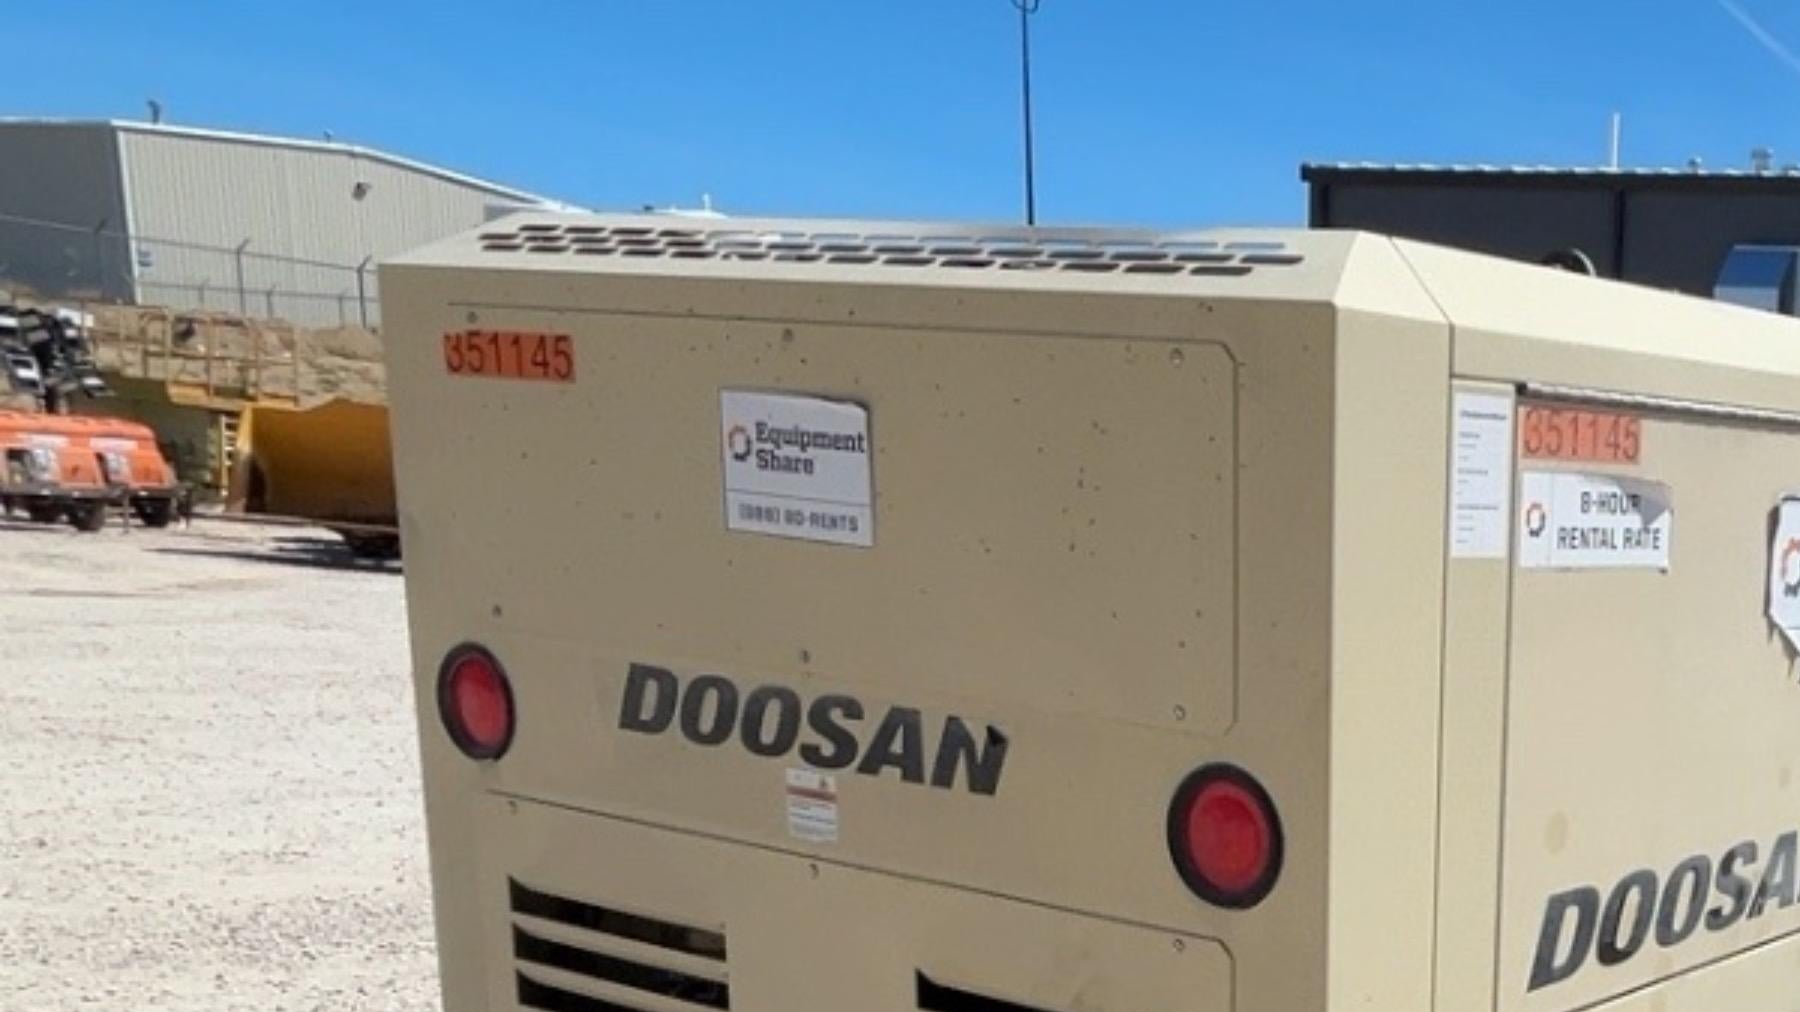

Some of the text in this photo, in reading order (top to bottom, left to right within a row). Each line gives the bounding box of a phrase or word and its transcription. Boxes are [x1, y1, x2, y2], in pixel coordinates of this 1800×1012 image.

[443, 331, 574, 379] 351145
[755, 420, 866, 454] Equipment
[1523, 407, 1639, 461] 351145
[755, 448, 815, 475] Share
[1556, 526, 1661, 550] RENTAL RATE
[618, 662, 1010, 796] DOOSAN
